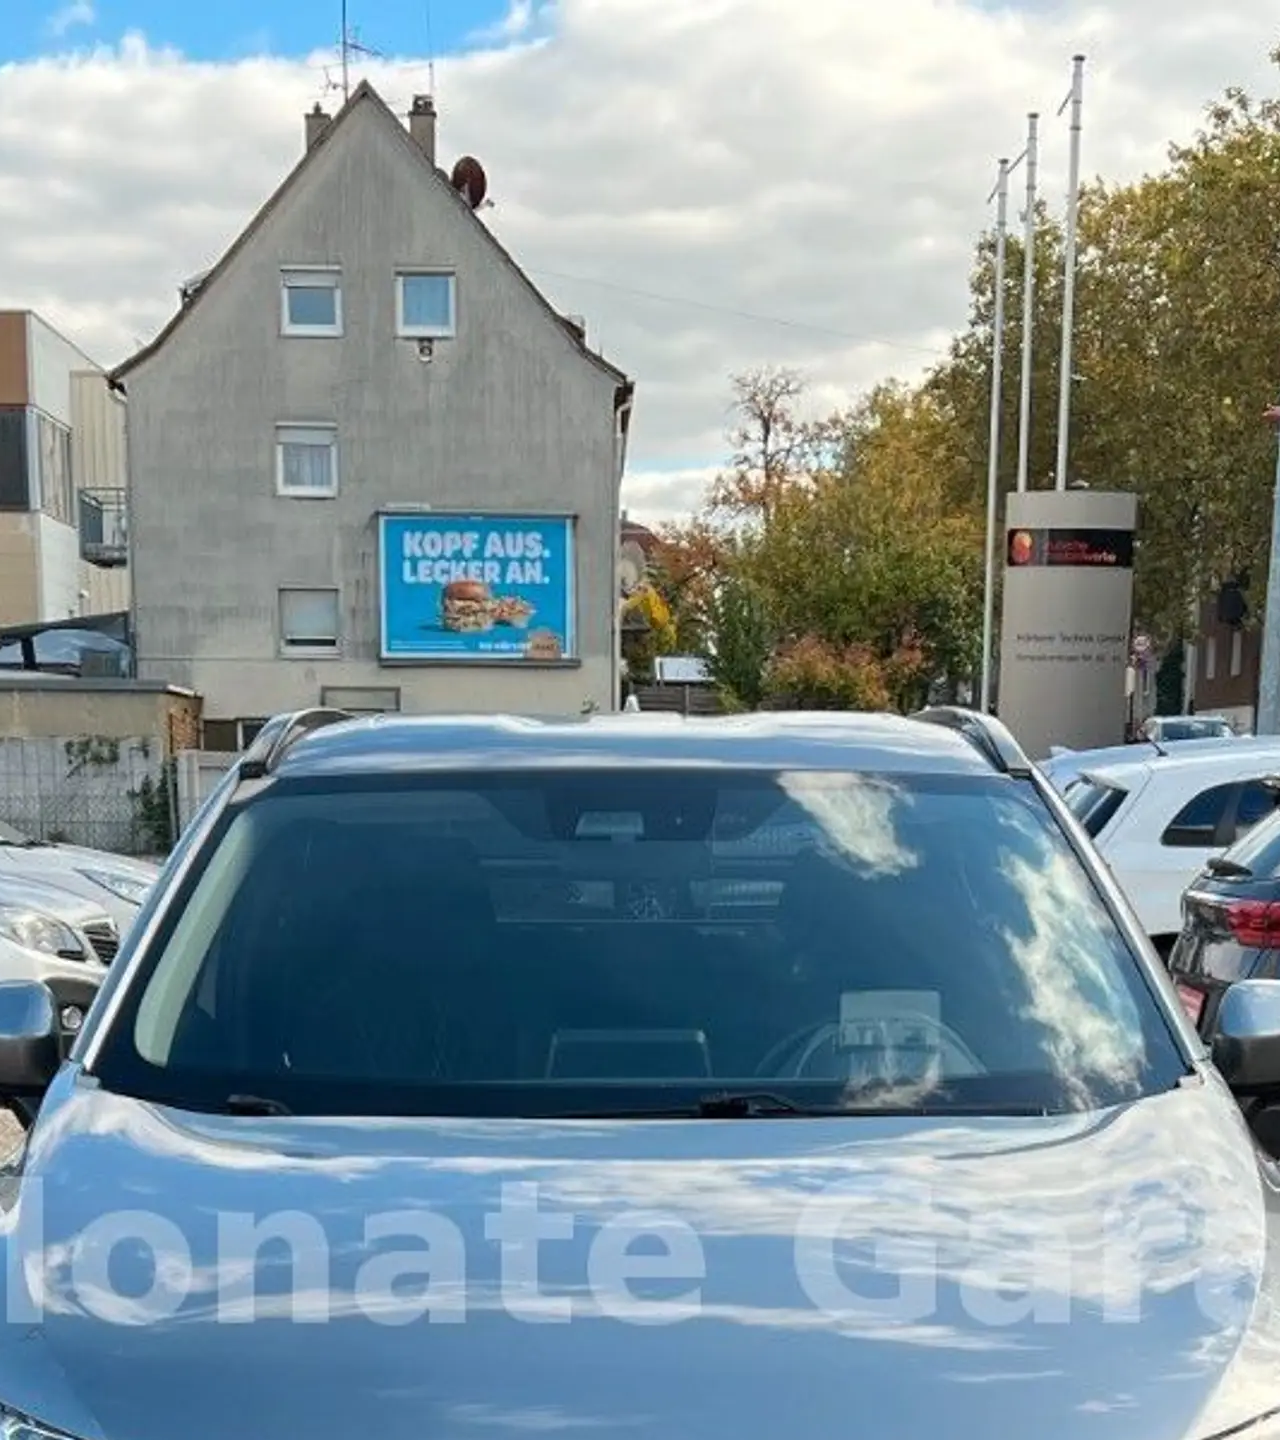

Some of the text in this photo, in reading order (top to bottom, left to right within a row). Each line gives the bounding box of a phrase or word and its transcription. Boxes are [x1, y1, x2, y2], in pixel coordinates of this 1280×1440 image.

[403, 531, 551, 558] KOPF AUS.
[403, 560, 550, 584] LECKER AN.
